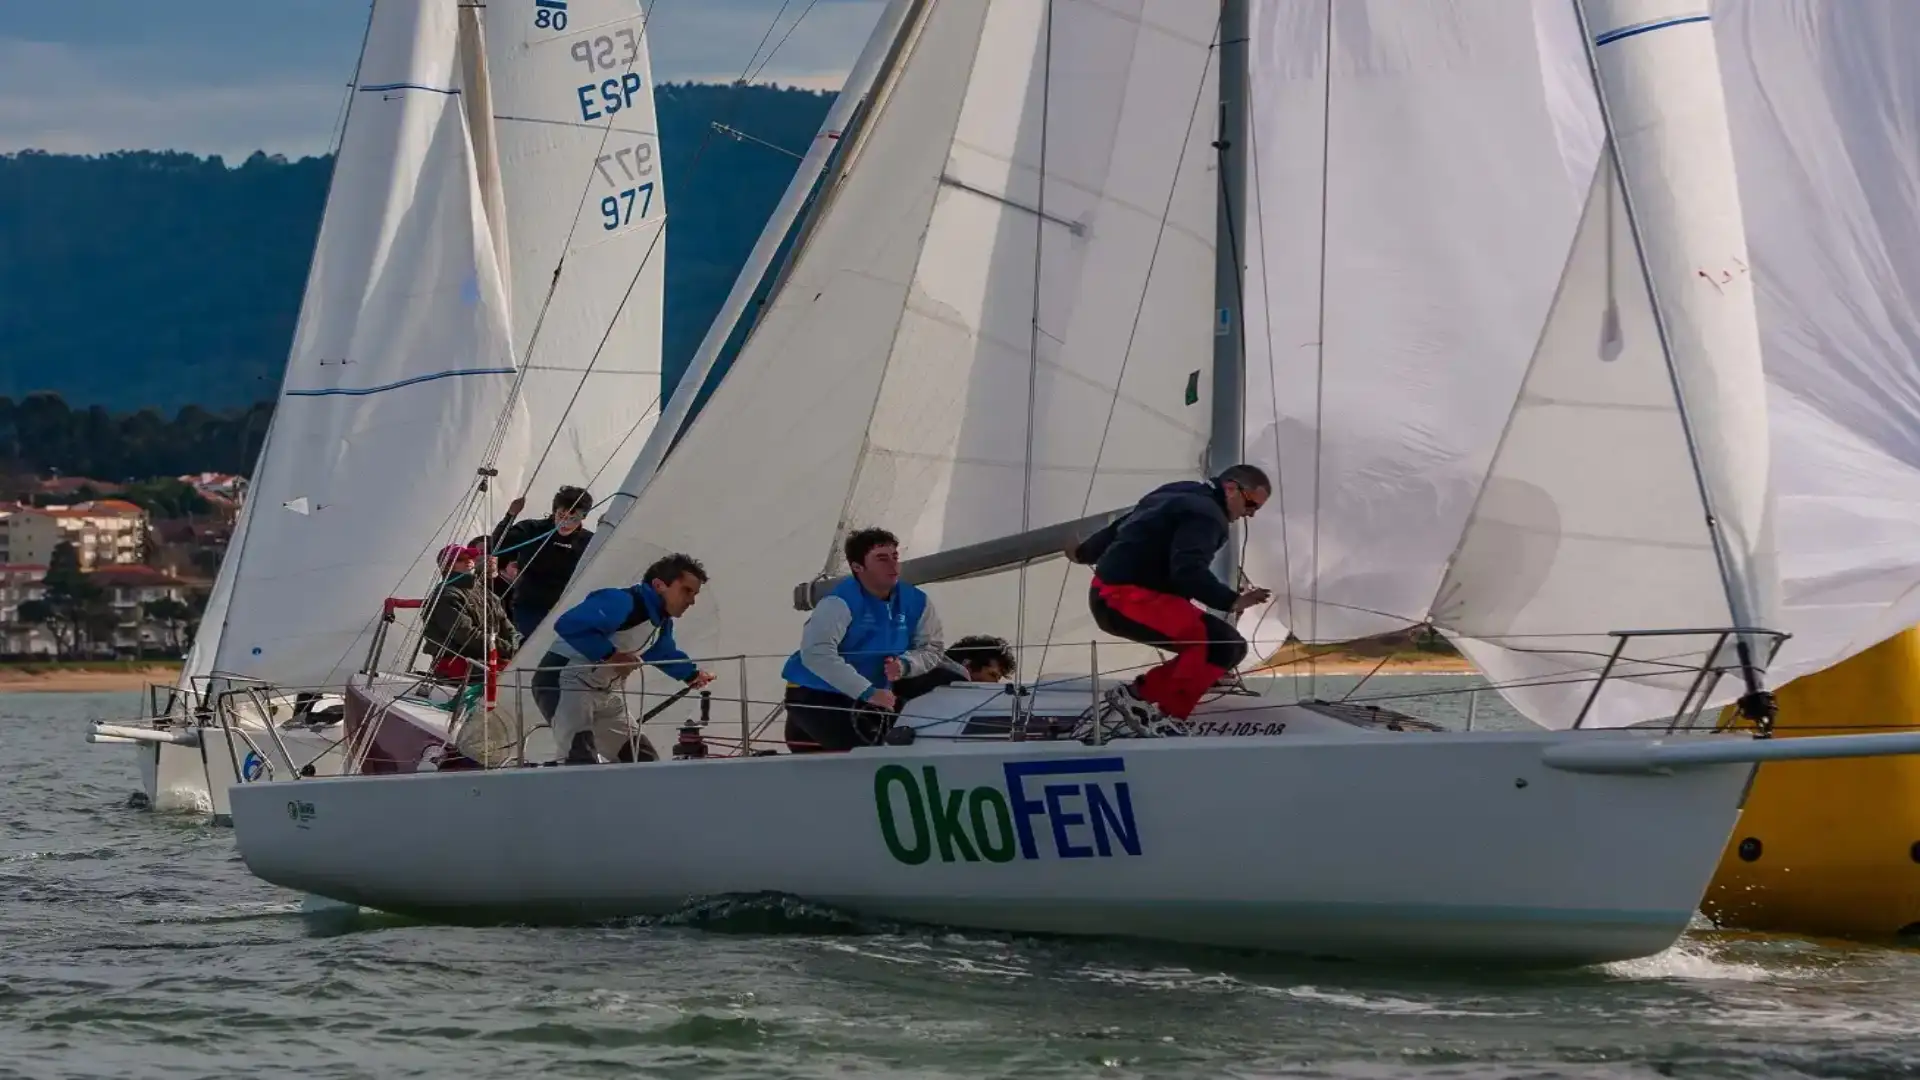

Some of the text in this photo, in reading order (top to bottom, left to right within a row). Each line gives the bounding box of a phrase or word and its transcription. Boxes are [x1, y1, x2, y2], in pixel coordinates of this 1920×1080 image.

[535, 9, 567, 31] 80
[577, 72, 641, 121] ESP
[601, 182, 654, 231] 977
[874, 757, 1143, 865] OkoFEN
